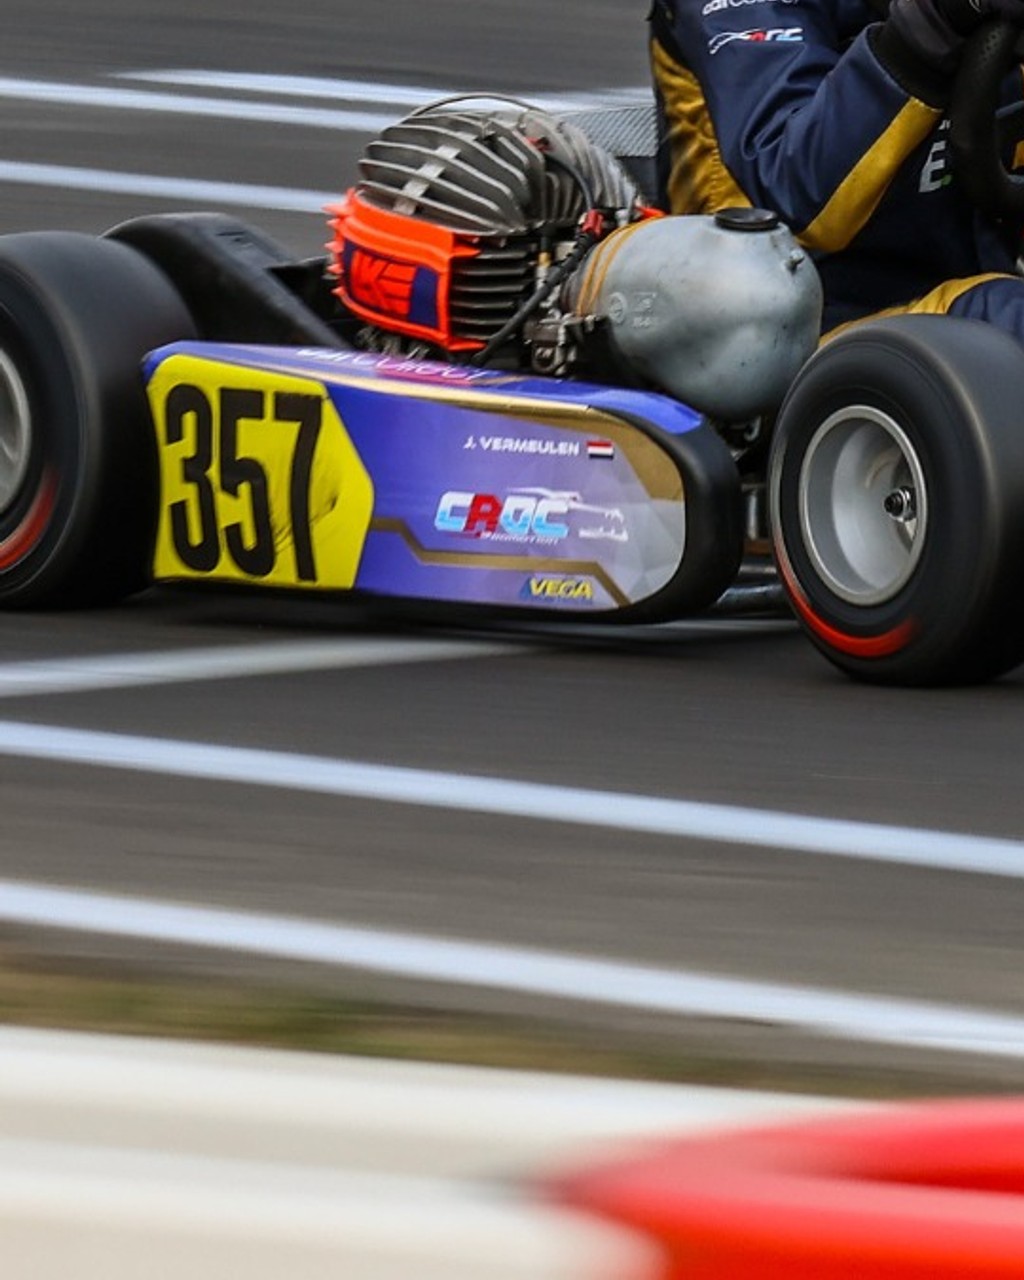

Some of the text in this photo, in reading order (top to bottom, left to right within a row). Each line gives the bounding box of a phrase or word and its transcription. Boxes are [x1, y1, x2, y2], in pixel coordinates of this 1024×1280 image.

[479, 437, 580, 457] VERMEULEN
[165, 382, 323, 583] 357
[529, 577, 594, 599] VEGA
